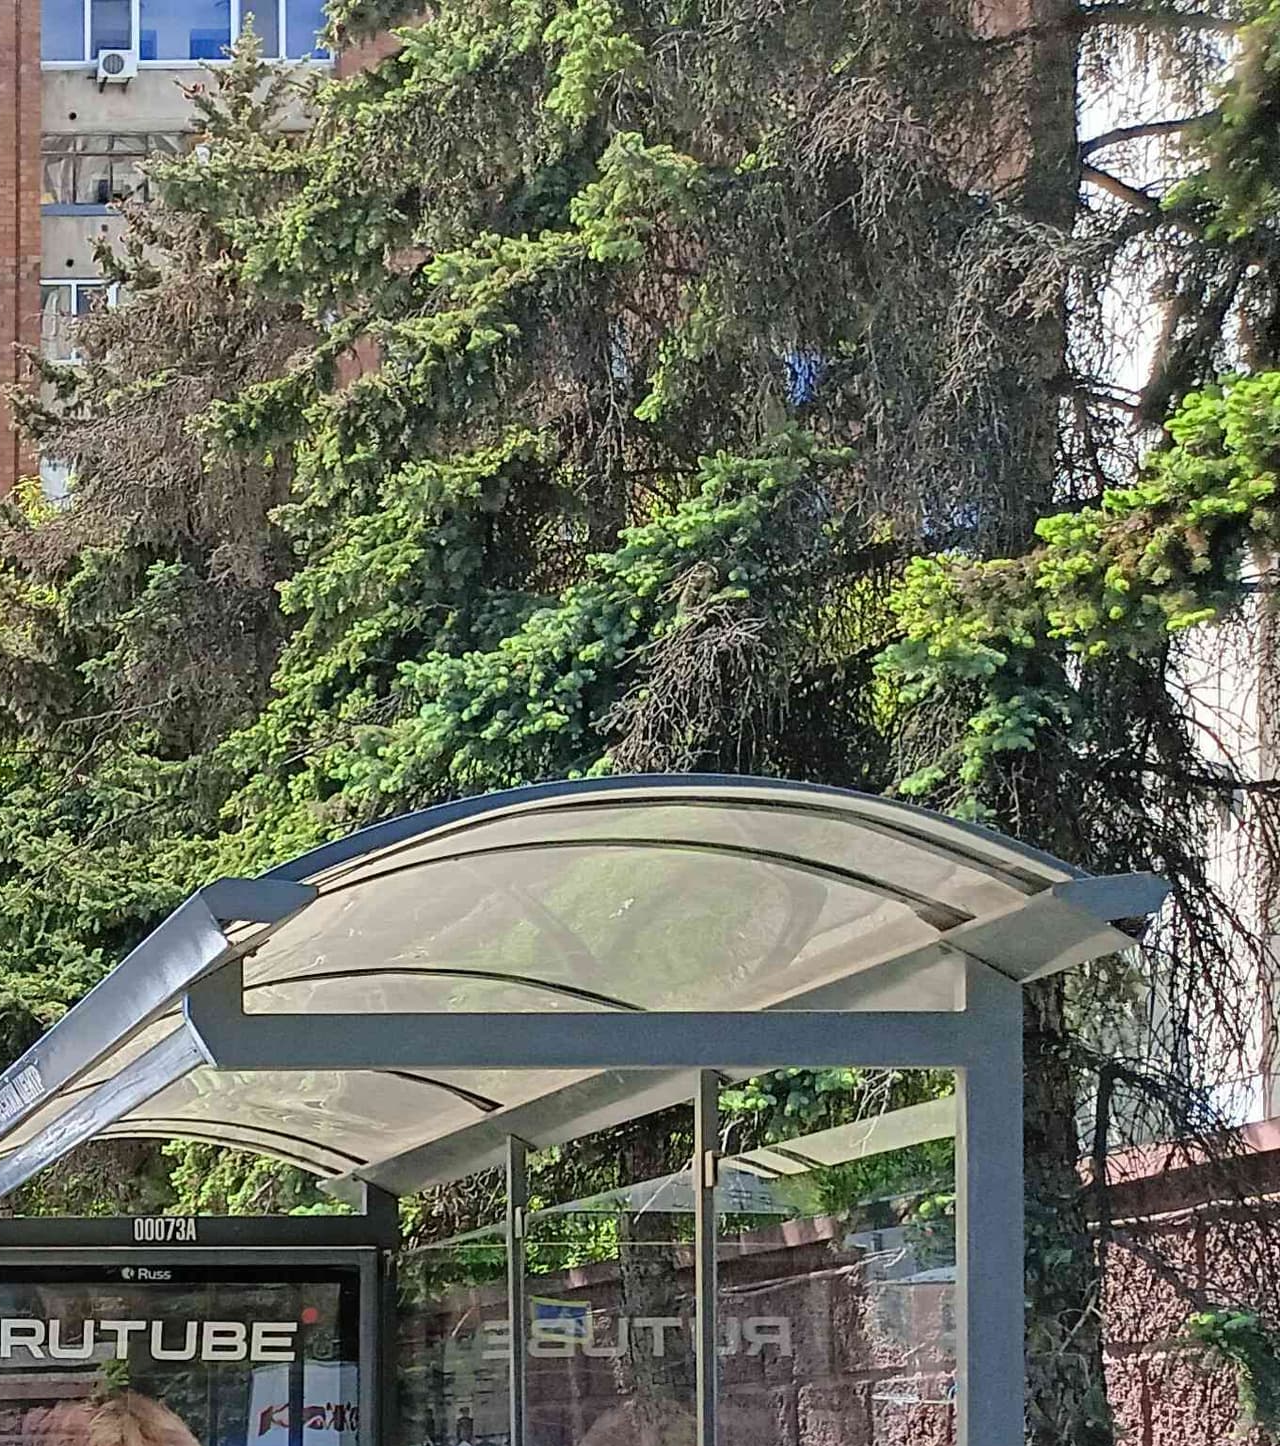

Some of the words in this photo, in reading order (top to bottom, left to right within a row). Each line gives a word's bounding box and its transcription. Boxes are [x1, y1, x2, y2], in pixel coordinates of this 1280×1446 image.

[134, 1218, 197, 1241] 00073A
[138, 1268, 172, 1280] Russ
[0, 1319, 298, 1362] RUTUBE
